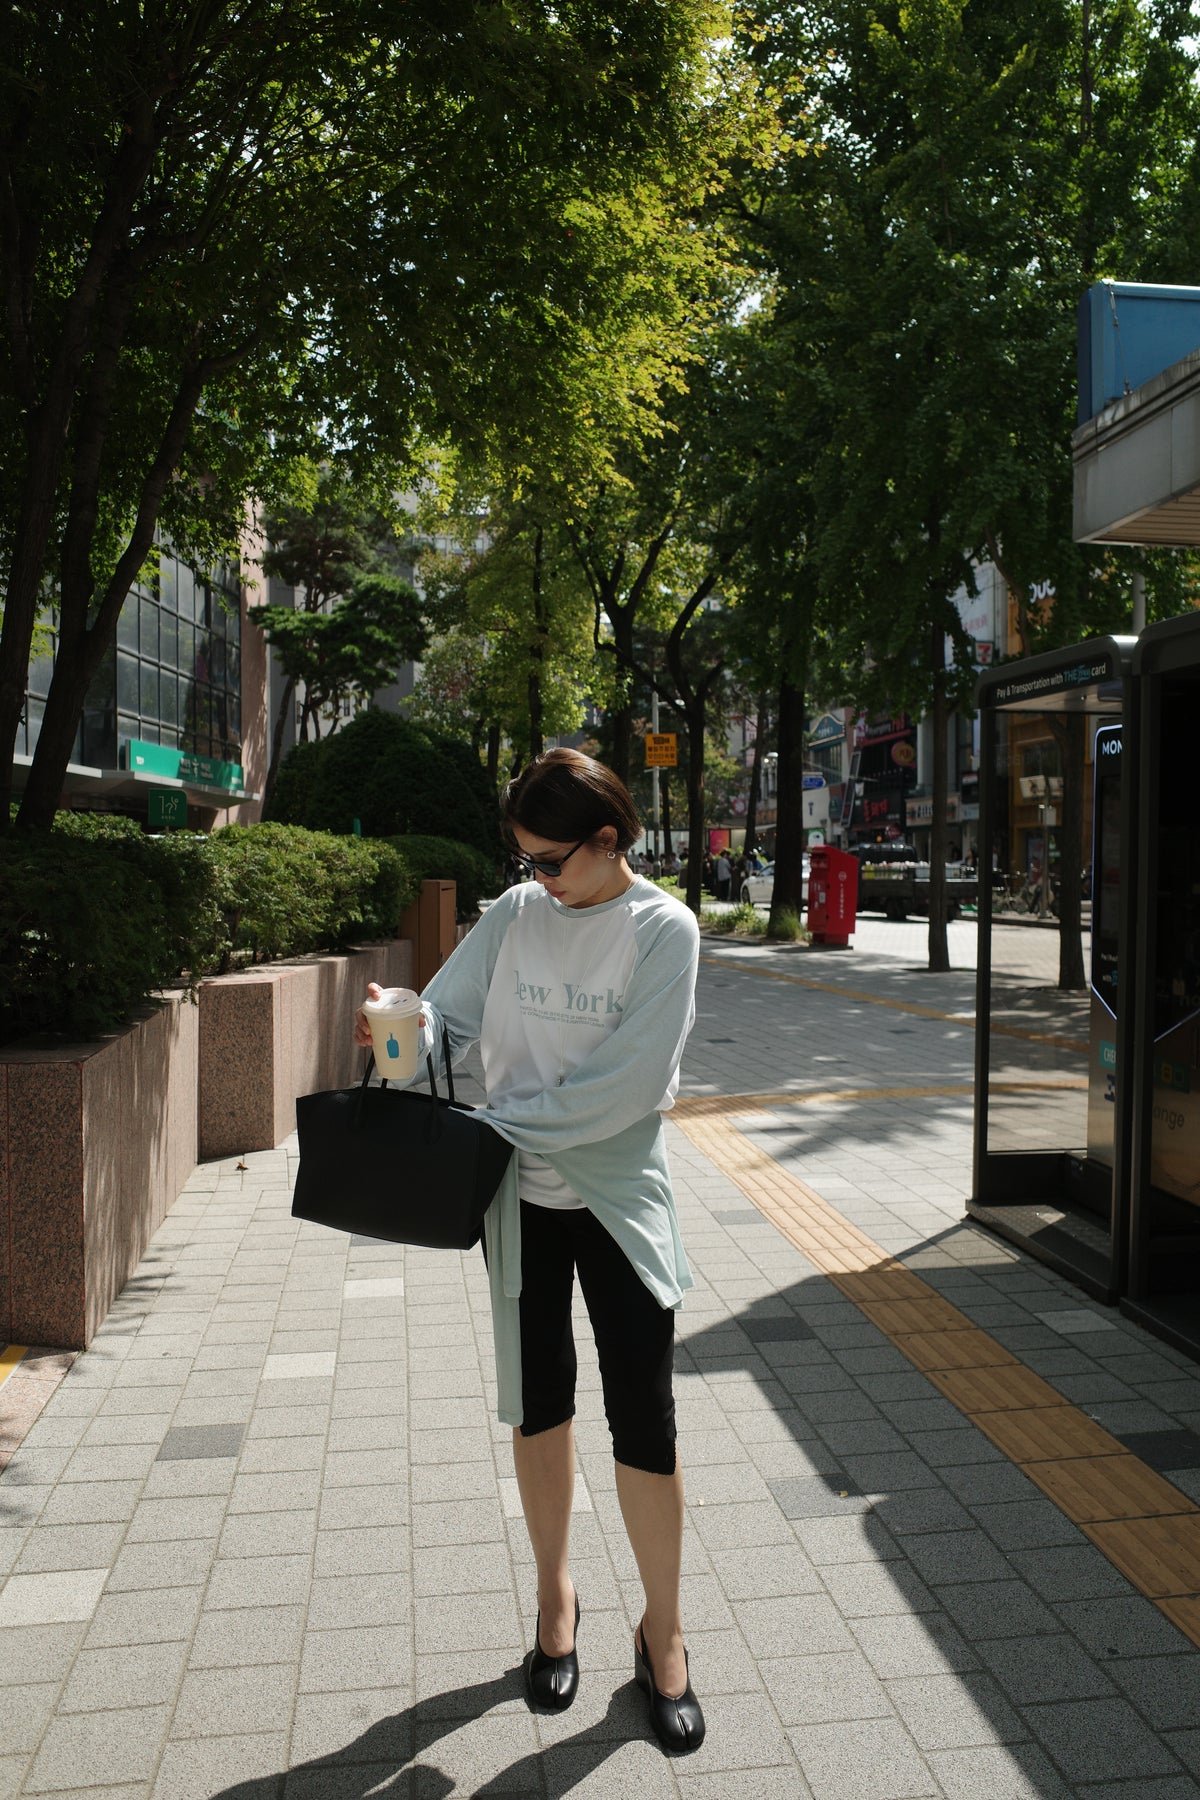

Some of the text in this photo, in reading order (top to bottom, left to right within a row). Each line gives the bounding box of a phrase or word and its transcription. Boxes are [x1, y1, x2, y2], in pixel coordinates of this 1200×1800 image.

[996, 688, 1007, 700] Pay
[1006, 687, 1011, 697] &
[1011, 677, 1050, 695] Transportation
[1050, 673, 1064, 686] with
[1090, 662, 1106, 677] card
[562, 982, 623, 1014] York
